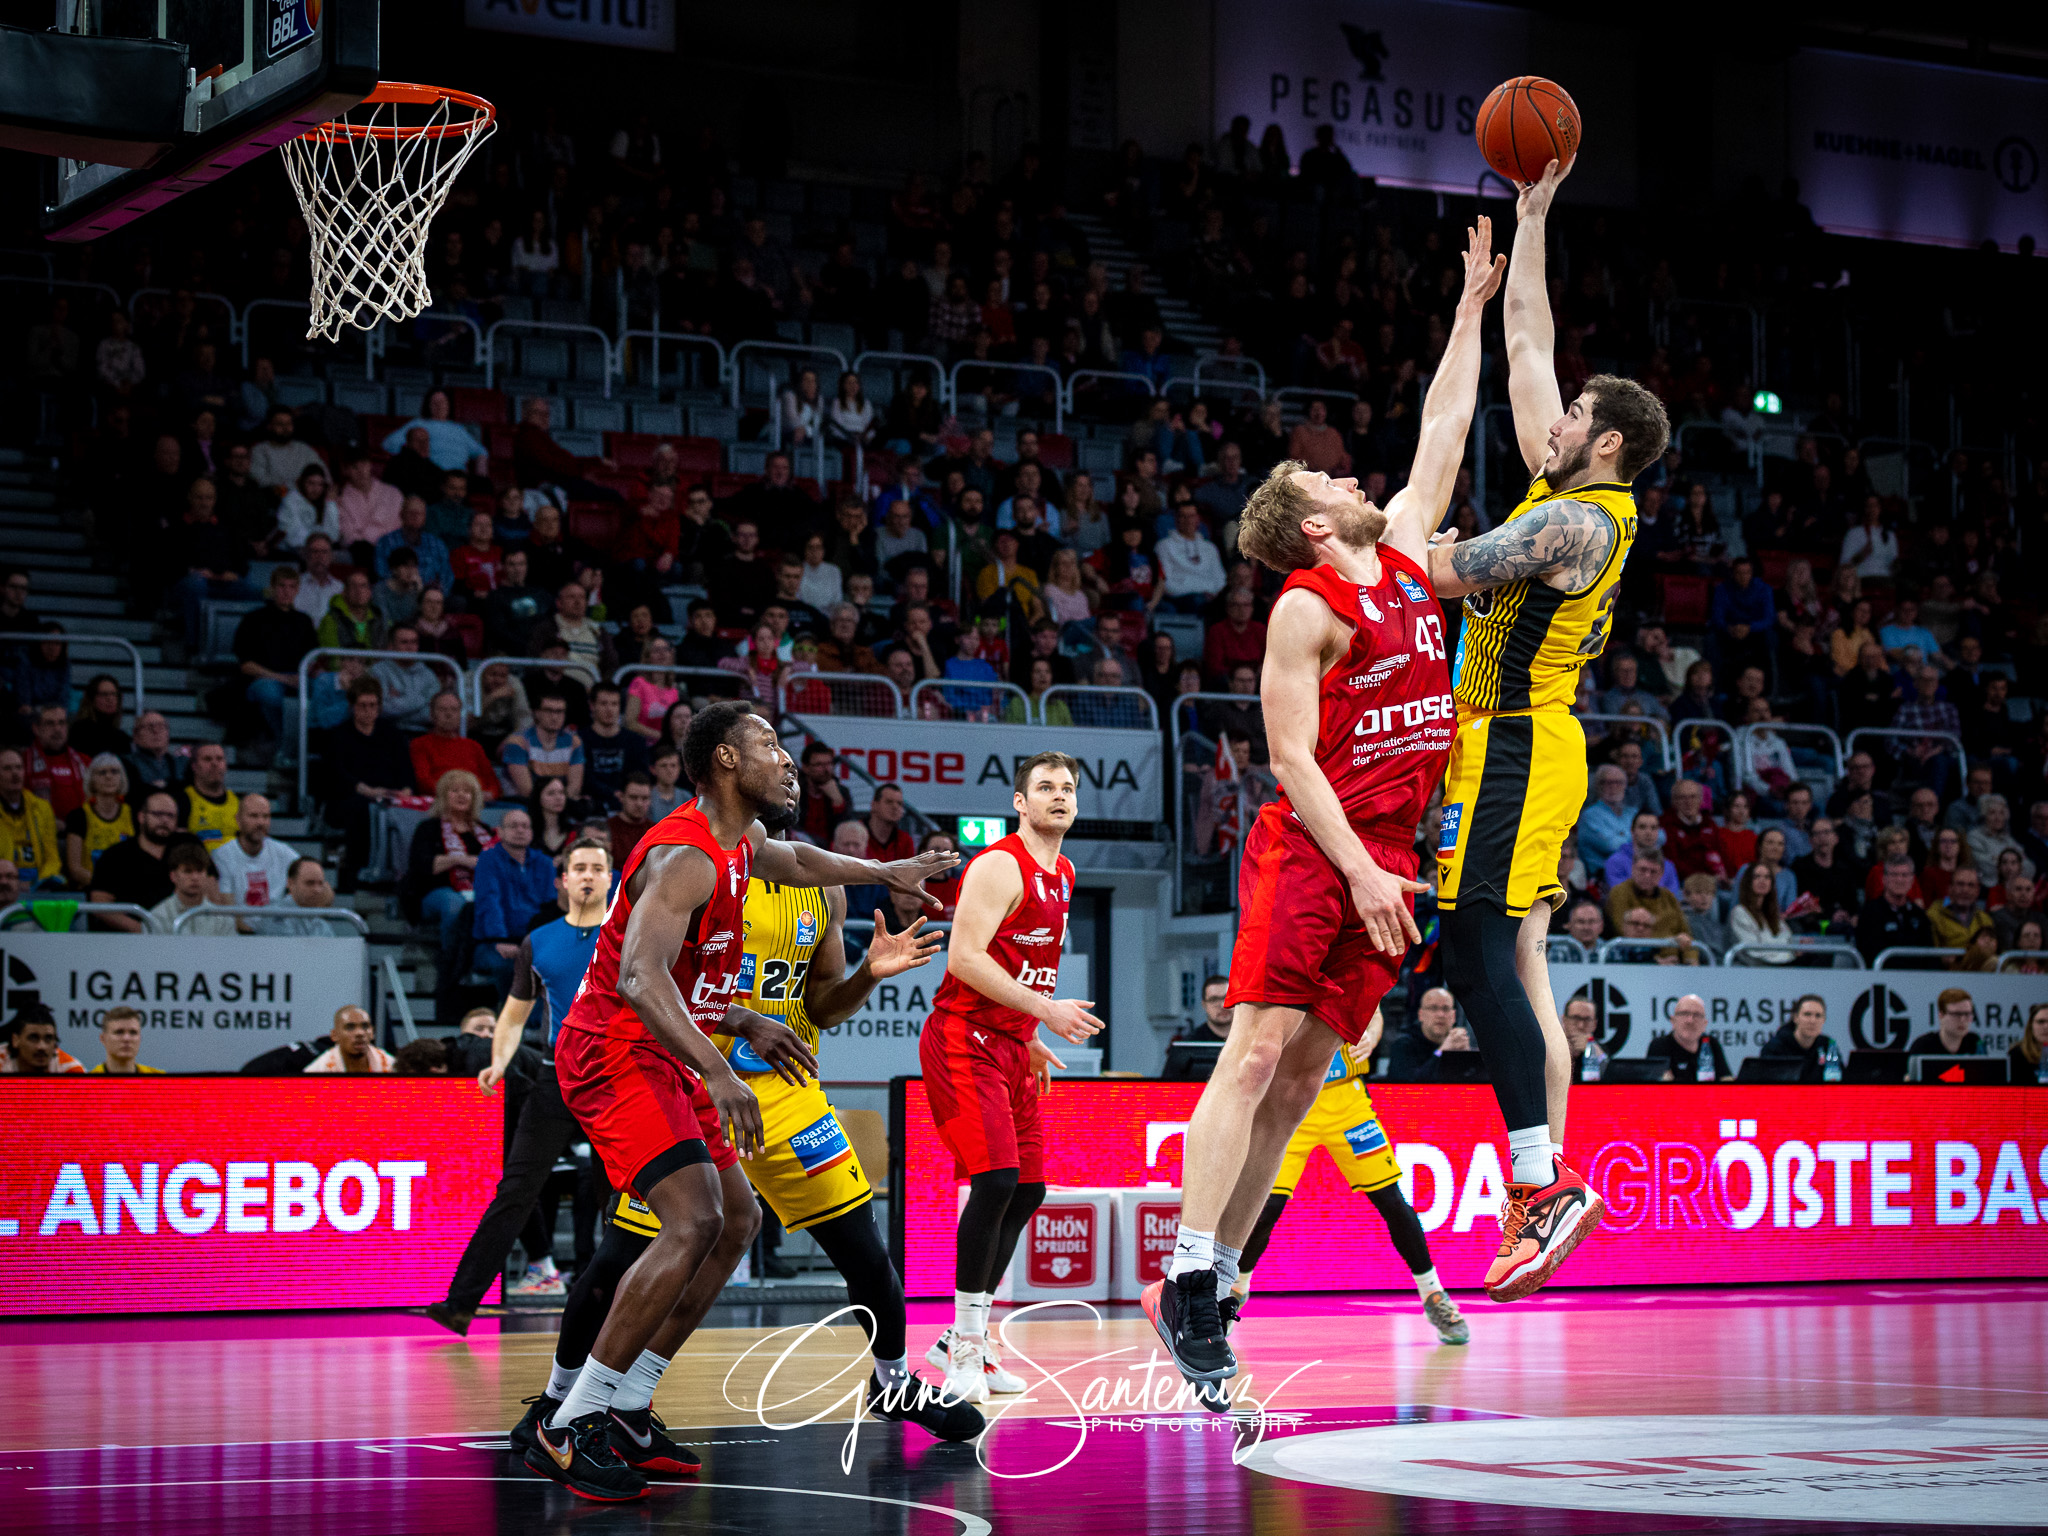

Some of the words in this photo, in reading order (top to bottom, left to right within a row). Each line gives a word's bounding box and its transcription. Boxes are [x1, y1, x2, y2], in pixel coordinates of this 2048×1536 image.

[271, 9, 299, 48] BBL
[1270, 73, 1475, 136] PEGASUS
[1415, 614, 1446, 661] 43
[1424, 727, 1452, 738] Partner
[838, 747, 965, 786] rose
[977, 752, 1140, 792] ANA
[1352, 755, 1371, 767] der
[68, 970, 293, 1003] IGARASHI
[759, 957, 811, 1002] 27
[213, 1010, 293, 1031] GMBH
[819, 1019, 920, 1038] OTOREN
[791, 1118, 836, 1148] Sparda
[809, 1126, 841, 1150] Bank
[38, 1159, 429, 1237] ANGEBOT
[1934, 1140, 2048, 1226] BA
[1143, 1212, 1181, 1237] RHÖ
[1034, 1240, 1089, 1254] SPRUDEL
[1143, 1238, 1175, 1252] SPRU
